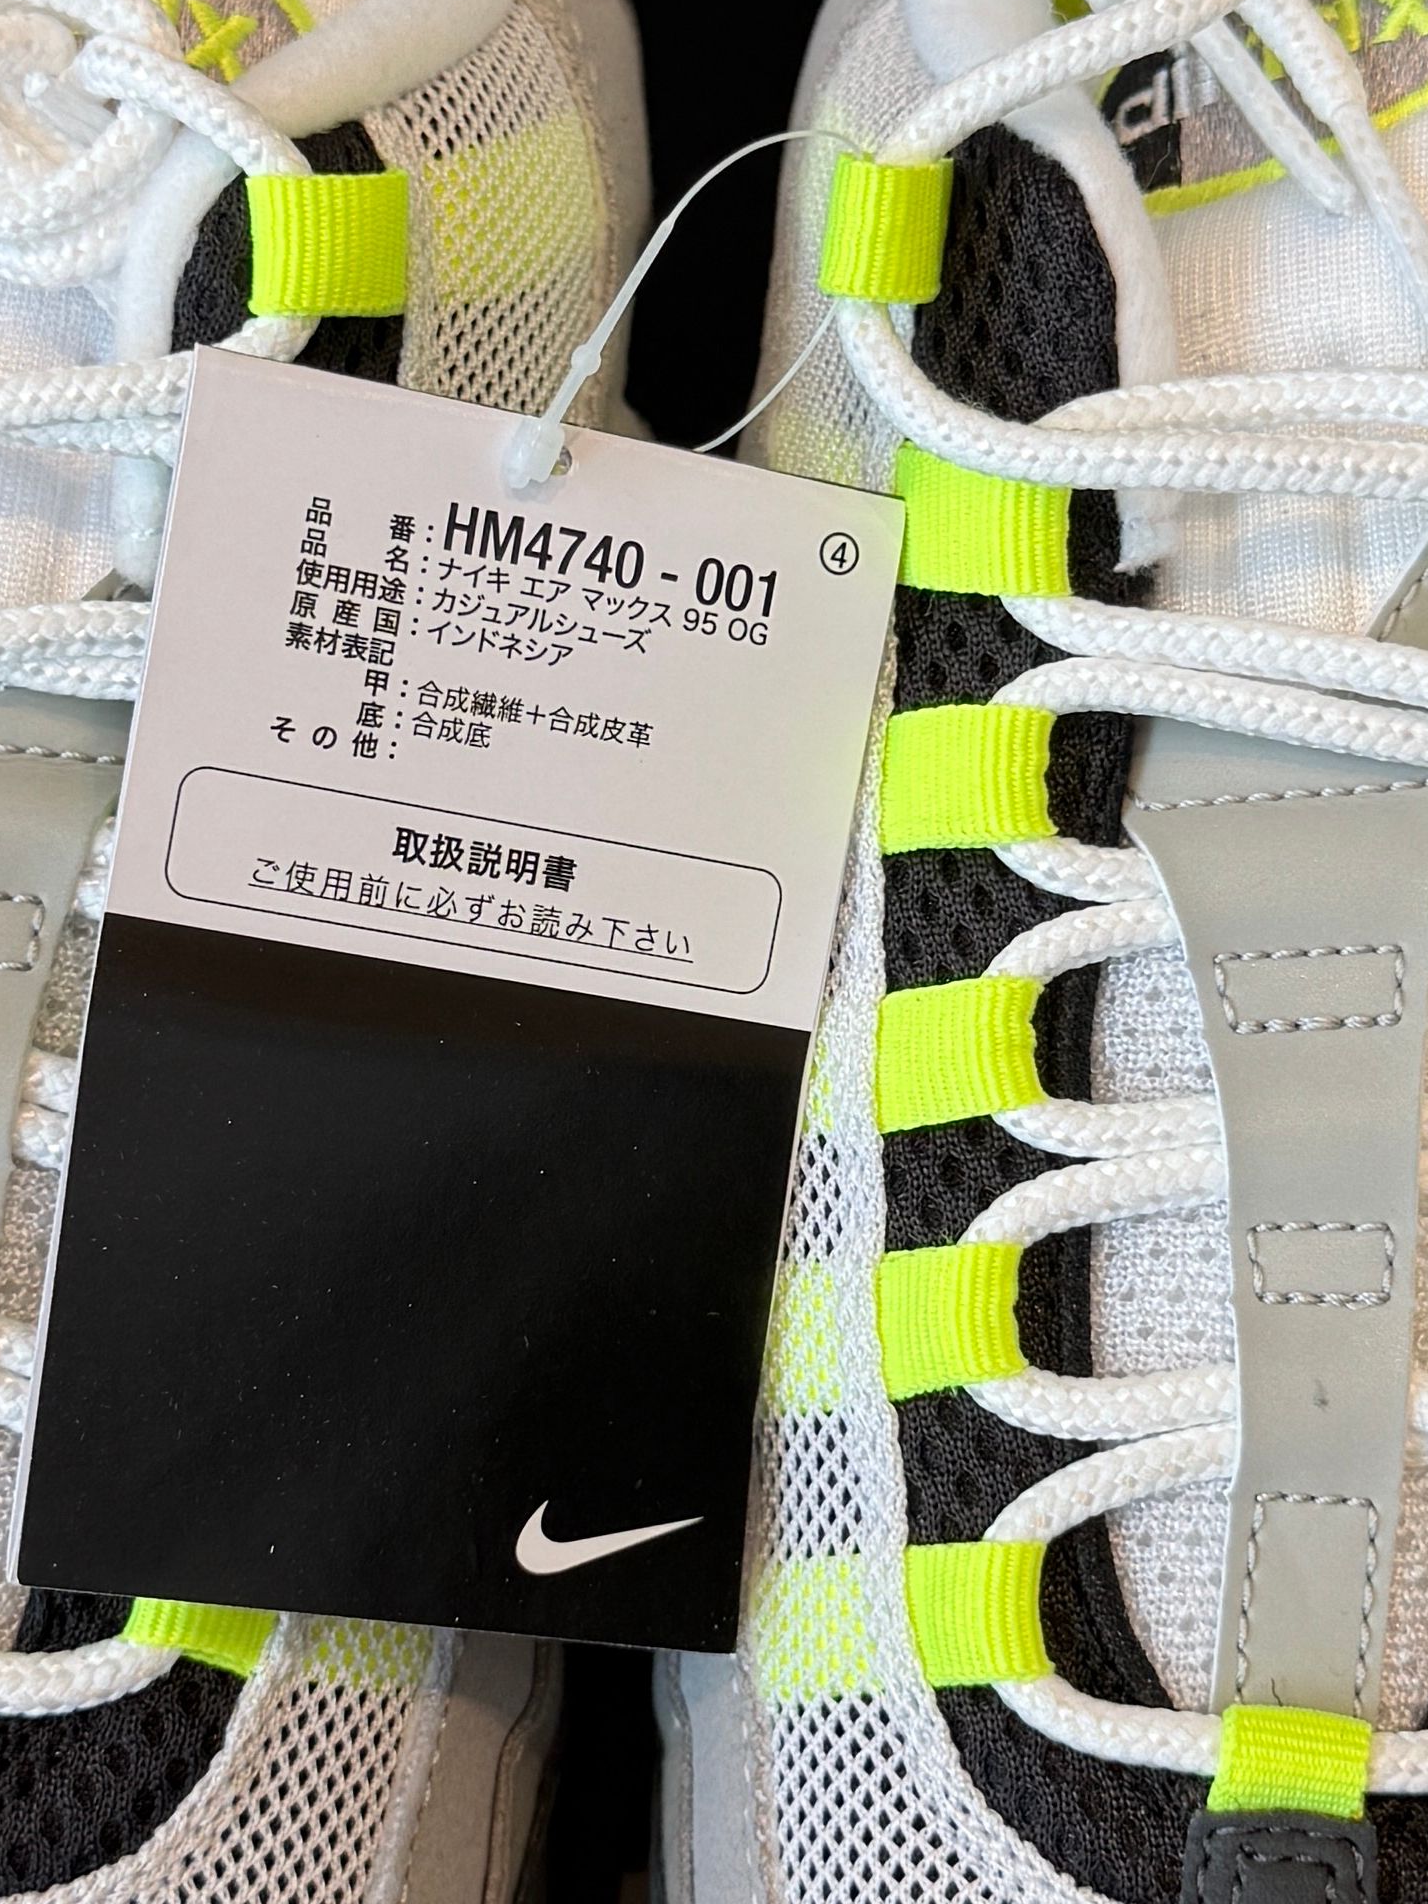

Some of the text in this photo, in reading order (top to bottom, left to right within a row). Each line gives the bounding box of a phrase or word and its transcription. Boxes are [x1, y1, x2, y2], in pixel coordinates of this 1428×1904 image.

[443, 502, 644, 589] HM4740
[695, 557, 778, 618] 001
[431, 587, 653, 655] カジュアルシューズ
[437, 557, 511, 594] ナイキ
[519, 576, 572, 604] エア
[581, 587, 672, 628] マックス
[682, 607, 719, 636] 95
[727, 617, 769, 646] OG
[284, 621, 396, 667] 素材表記
[426, 620, 574, 667] インドネシア
[411, 710, 493, 749] 合成底
[391, 826, 578, 893] 取扱説明書
[250, 857, 691, 957] ご使用前に必ずお読み下さい
